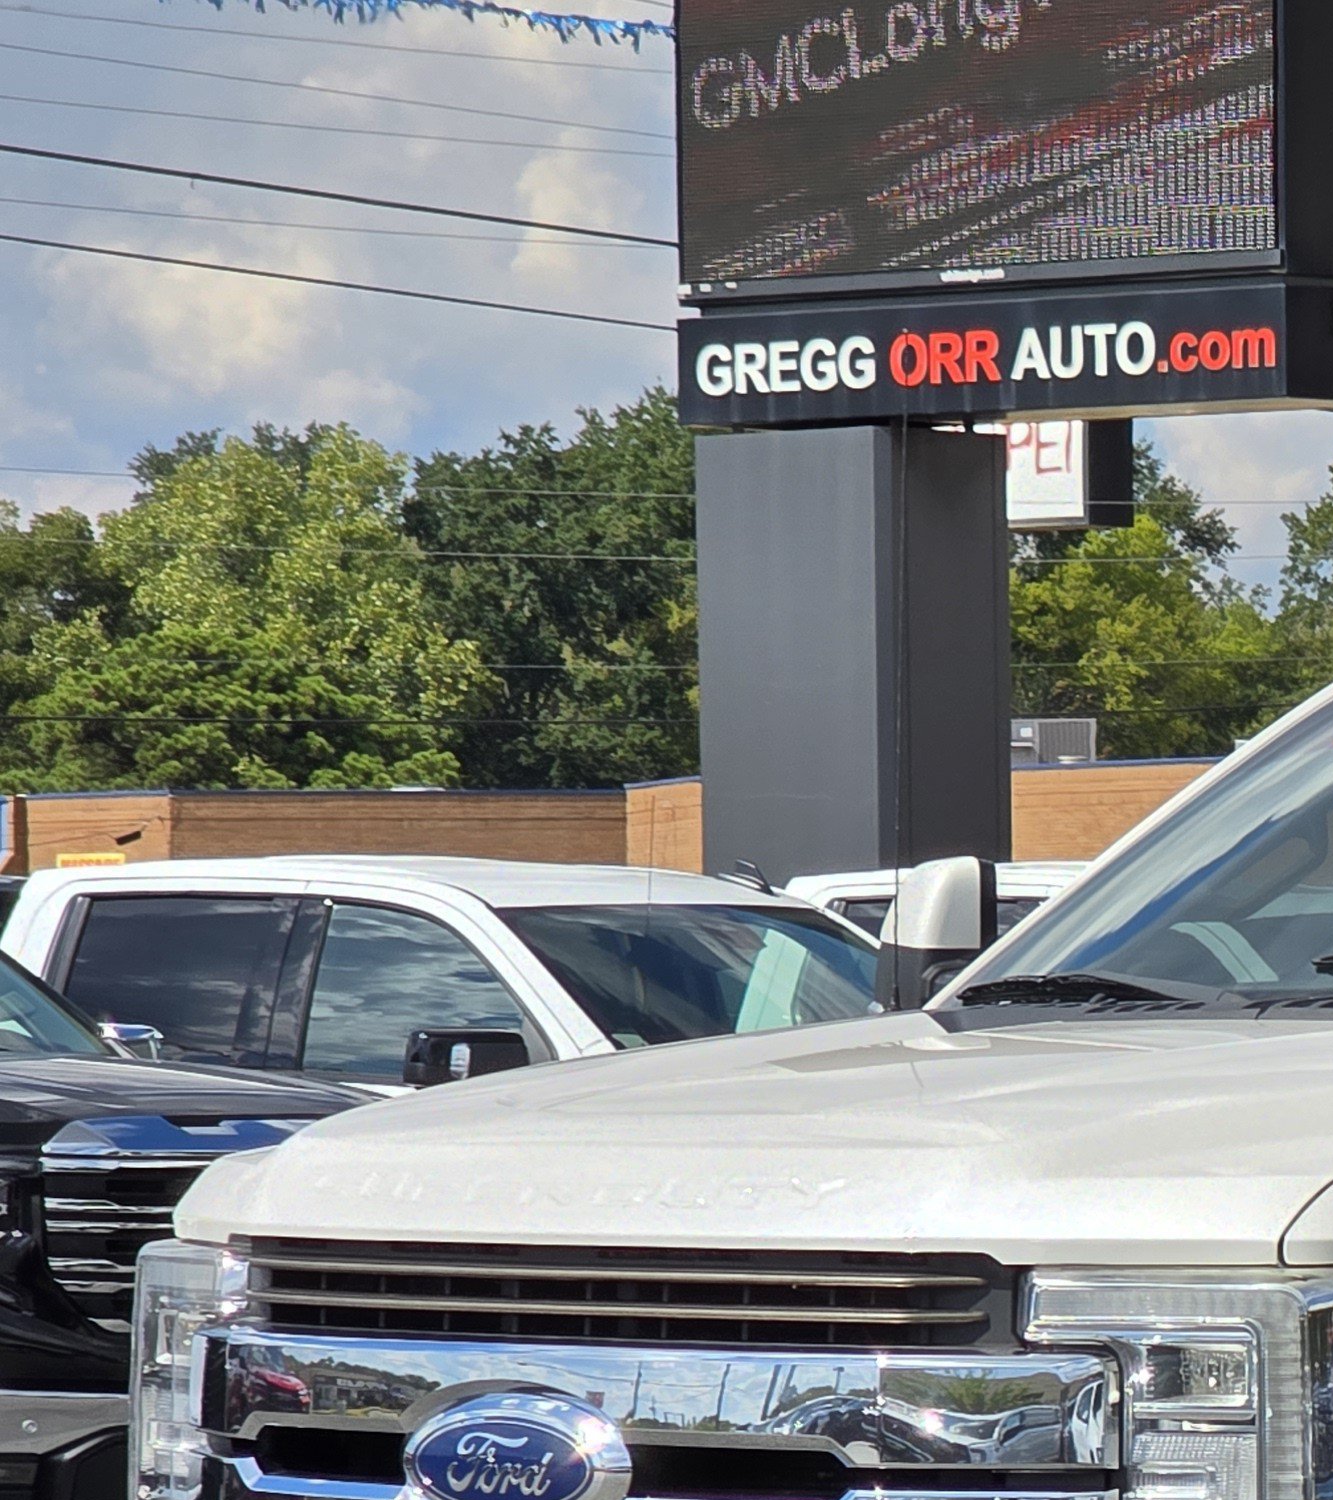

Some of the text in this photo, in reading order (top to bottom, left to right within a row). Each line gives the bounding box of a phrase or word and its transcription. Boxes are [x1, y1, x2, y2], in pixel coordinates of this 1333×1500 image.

[696, 321, 1276, 396] GREGG ORR AUTO.com
[446, 1432, 554, 1496] Ford
